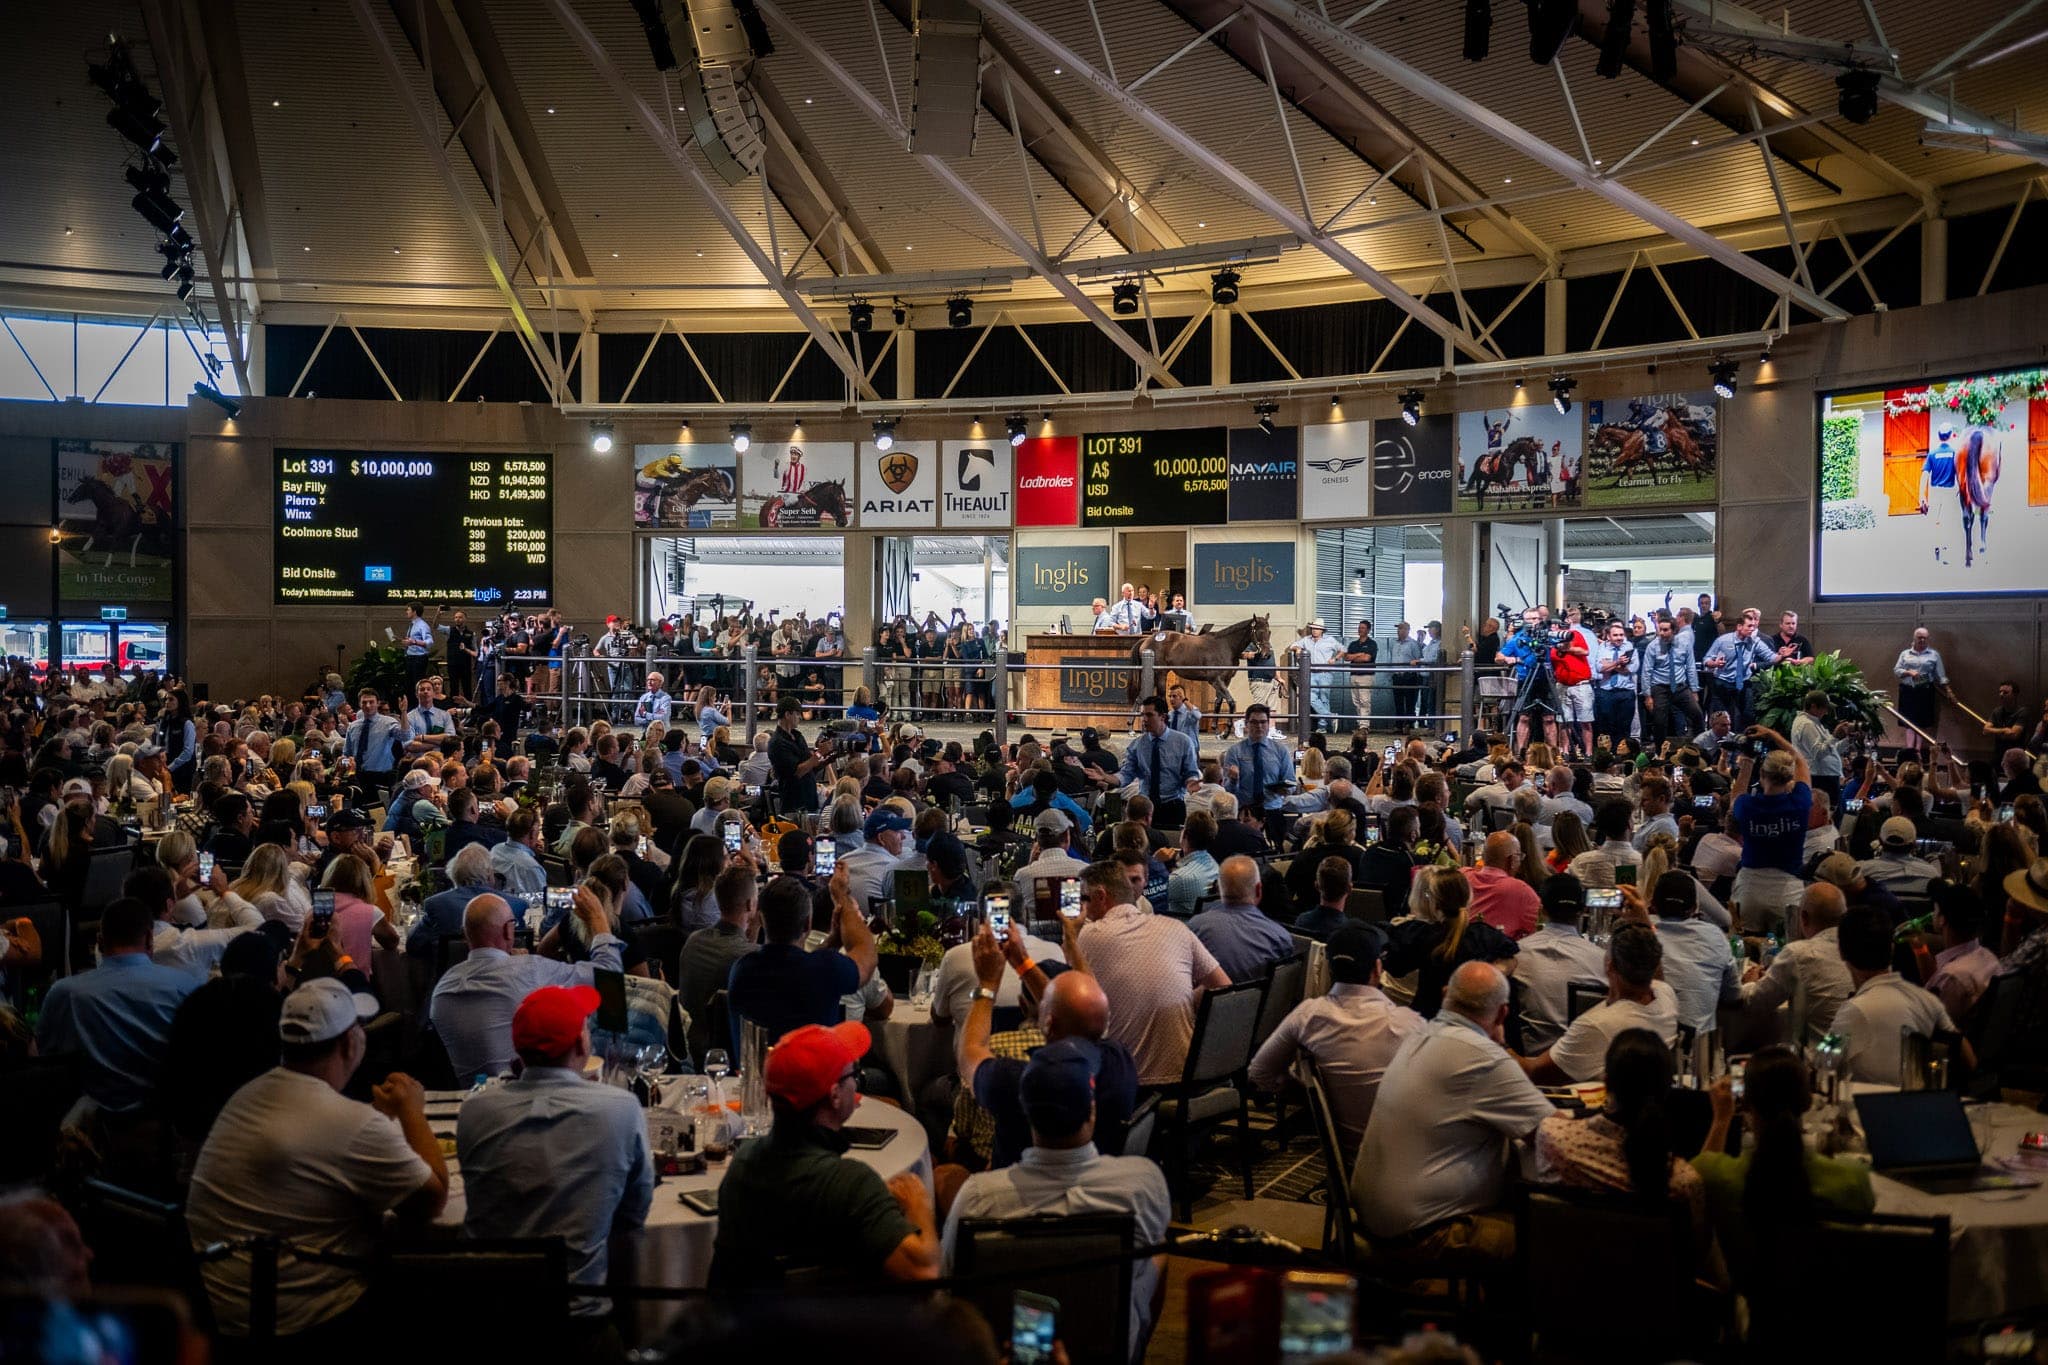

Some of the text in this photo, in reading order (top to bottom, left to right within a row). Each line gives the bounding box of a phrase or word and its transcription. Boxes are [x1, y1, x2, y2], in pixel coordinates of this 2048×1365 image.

[1088, 437, 1142, 455] LOT 391
[283, 458, 334, 474] Lot 391
[470, 461, 546, 472] USD 6,578,500
[1092, 457, 1226, 479] A$ 10,000,000
[1230, 461, 1297, 475] NAVAIR
[1322, 476, 1349, 485] GENESIS
[1418, 469, 1452, 480] encore
[470, 476, 490, 486] NZD
[1019, 475, 1074, 490] Ladbrokes
[1618, 474, 1683, 488] Learning To Fly
[282, 481, 327, 494] Bay Filly
[1087, 479, 1228, 496] USD 6,578,500
[1523, 483, 1551, 494] Express
[285, 495, 317, 505] Pierro
[470, 489, 546, 500] HKD 51,499,300
[862, 500, 935, 513] ARIAT
[944, 491, 1009, 511] THEAULT
[285, 508, 311, 520] Winx
[779, 507, 817, 516] Super Seth
[1087, 505, 1134, 517] Bid Onsite
[463, 517, 524, 527] Previous lots:
[283, 526, 359, 538] Coolmore Stud
[469, 530, 546, 540] 390 $200,000
[507, 542, 546, 552] $160,000
[527, 554, 546, 564] W/D
[282, 567, 336, 578] Bid Onsite
[1034, 560, 1089, 592] Inglis
[1214, 557, 1276, 591] Inglis
[76, 573, 156, 588] In The Congo
[474, 587, 502, 601] Inglis
[533, 590, 547, 599] PM
[1068, 664, 1129, 697] Inglis
[1748, 817, 1801, 839] Inglis
